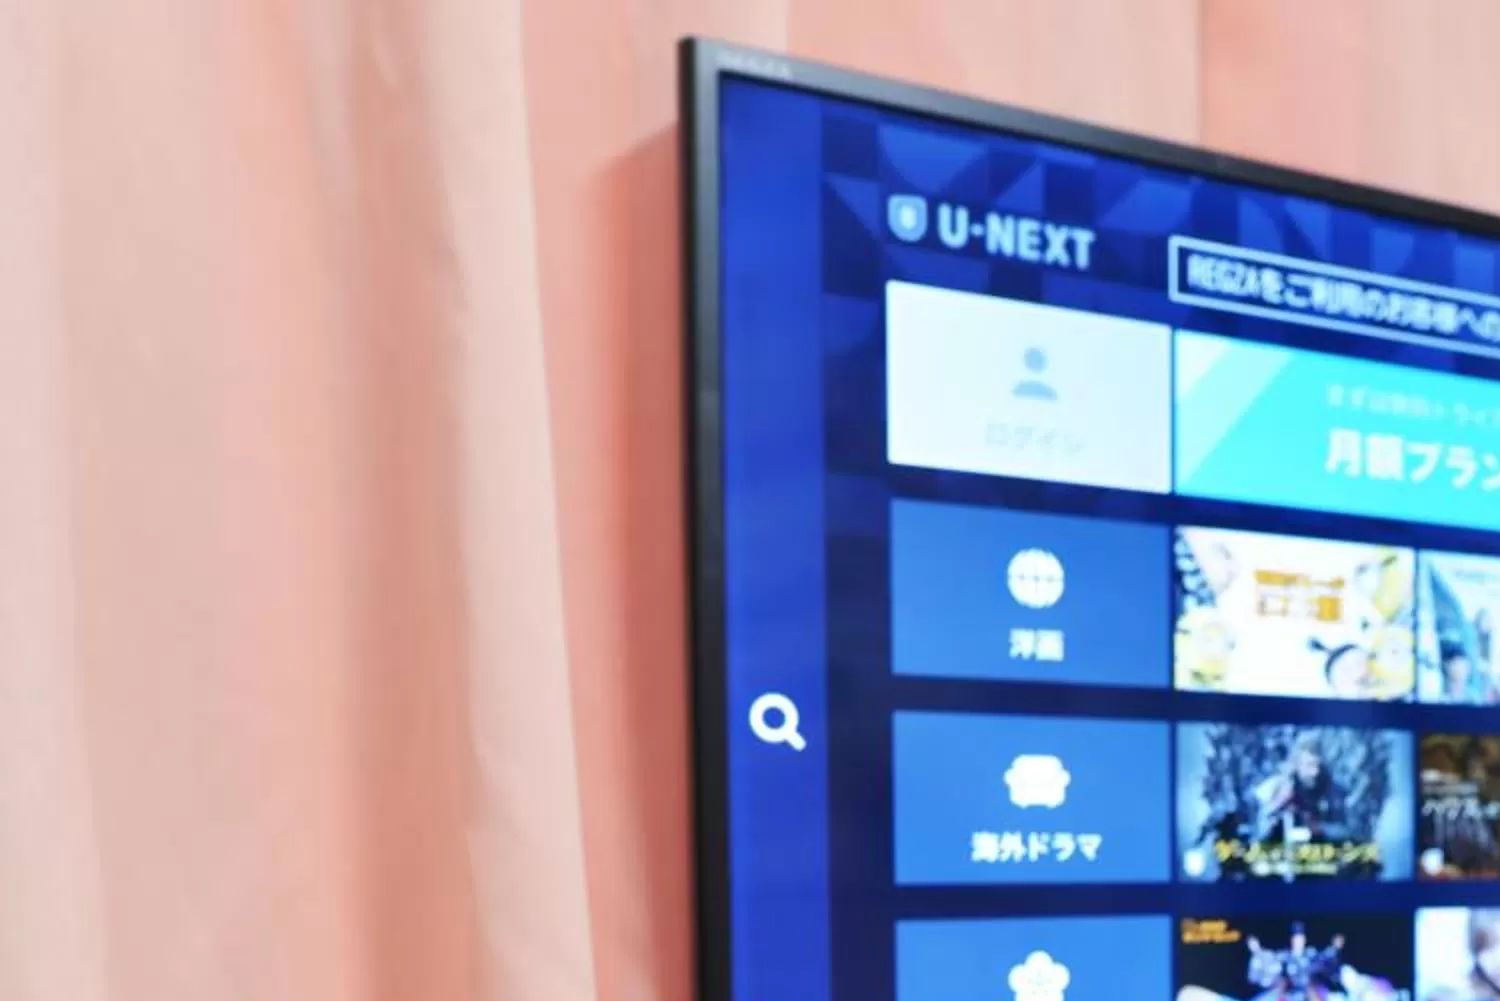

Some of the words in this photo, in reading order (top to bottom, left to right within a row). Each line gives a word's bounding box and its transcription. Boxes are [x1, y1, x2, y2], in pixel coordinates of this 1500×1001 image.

[970, 829, 1103, 863] 海外ドラマ
